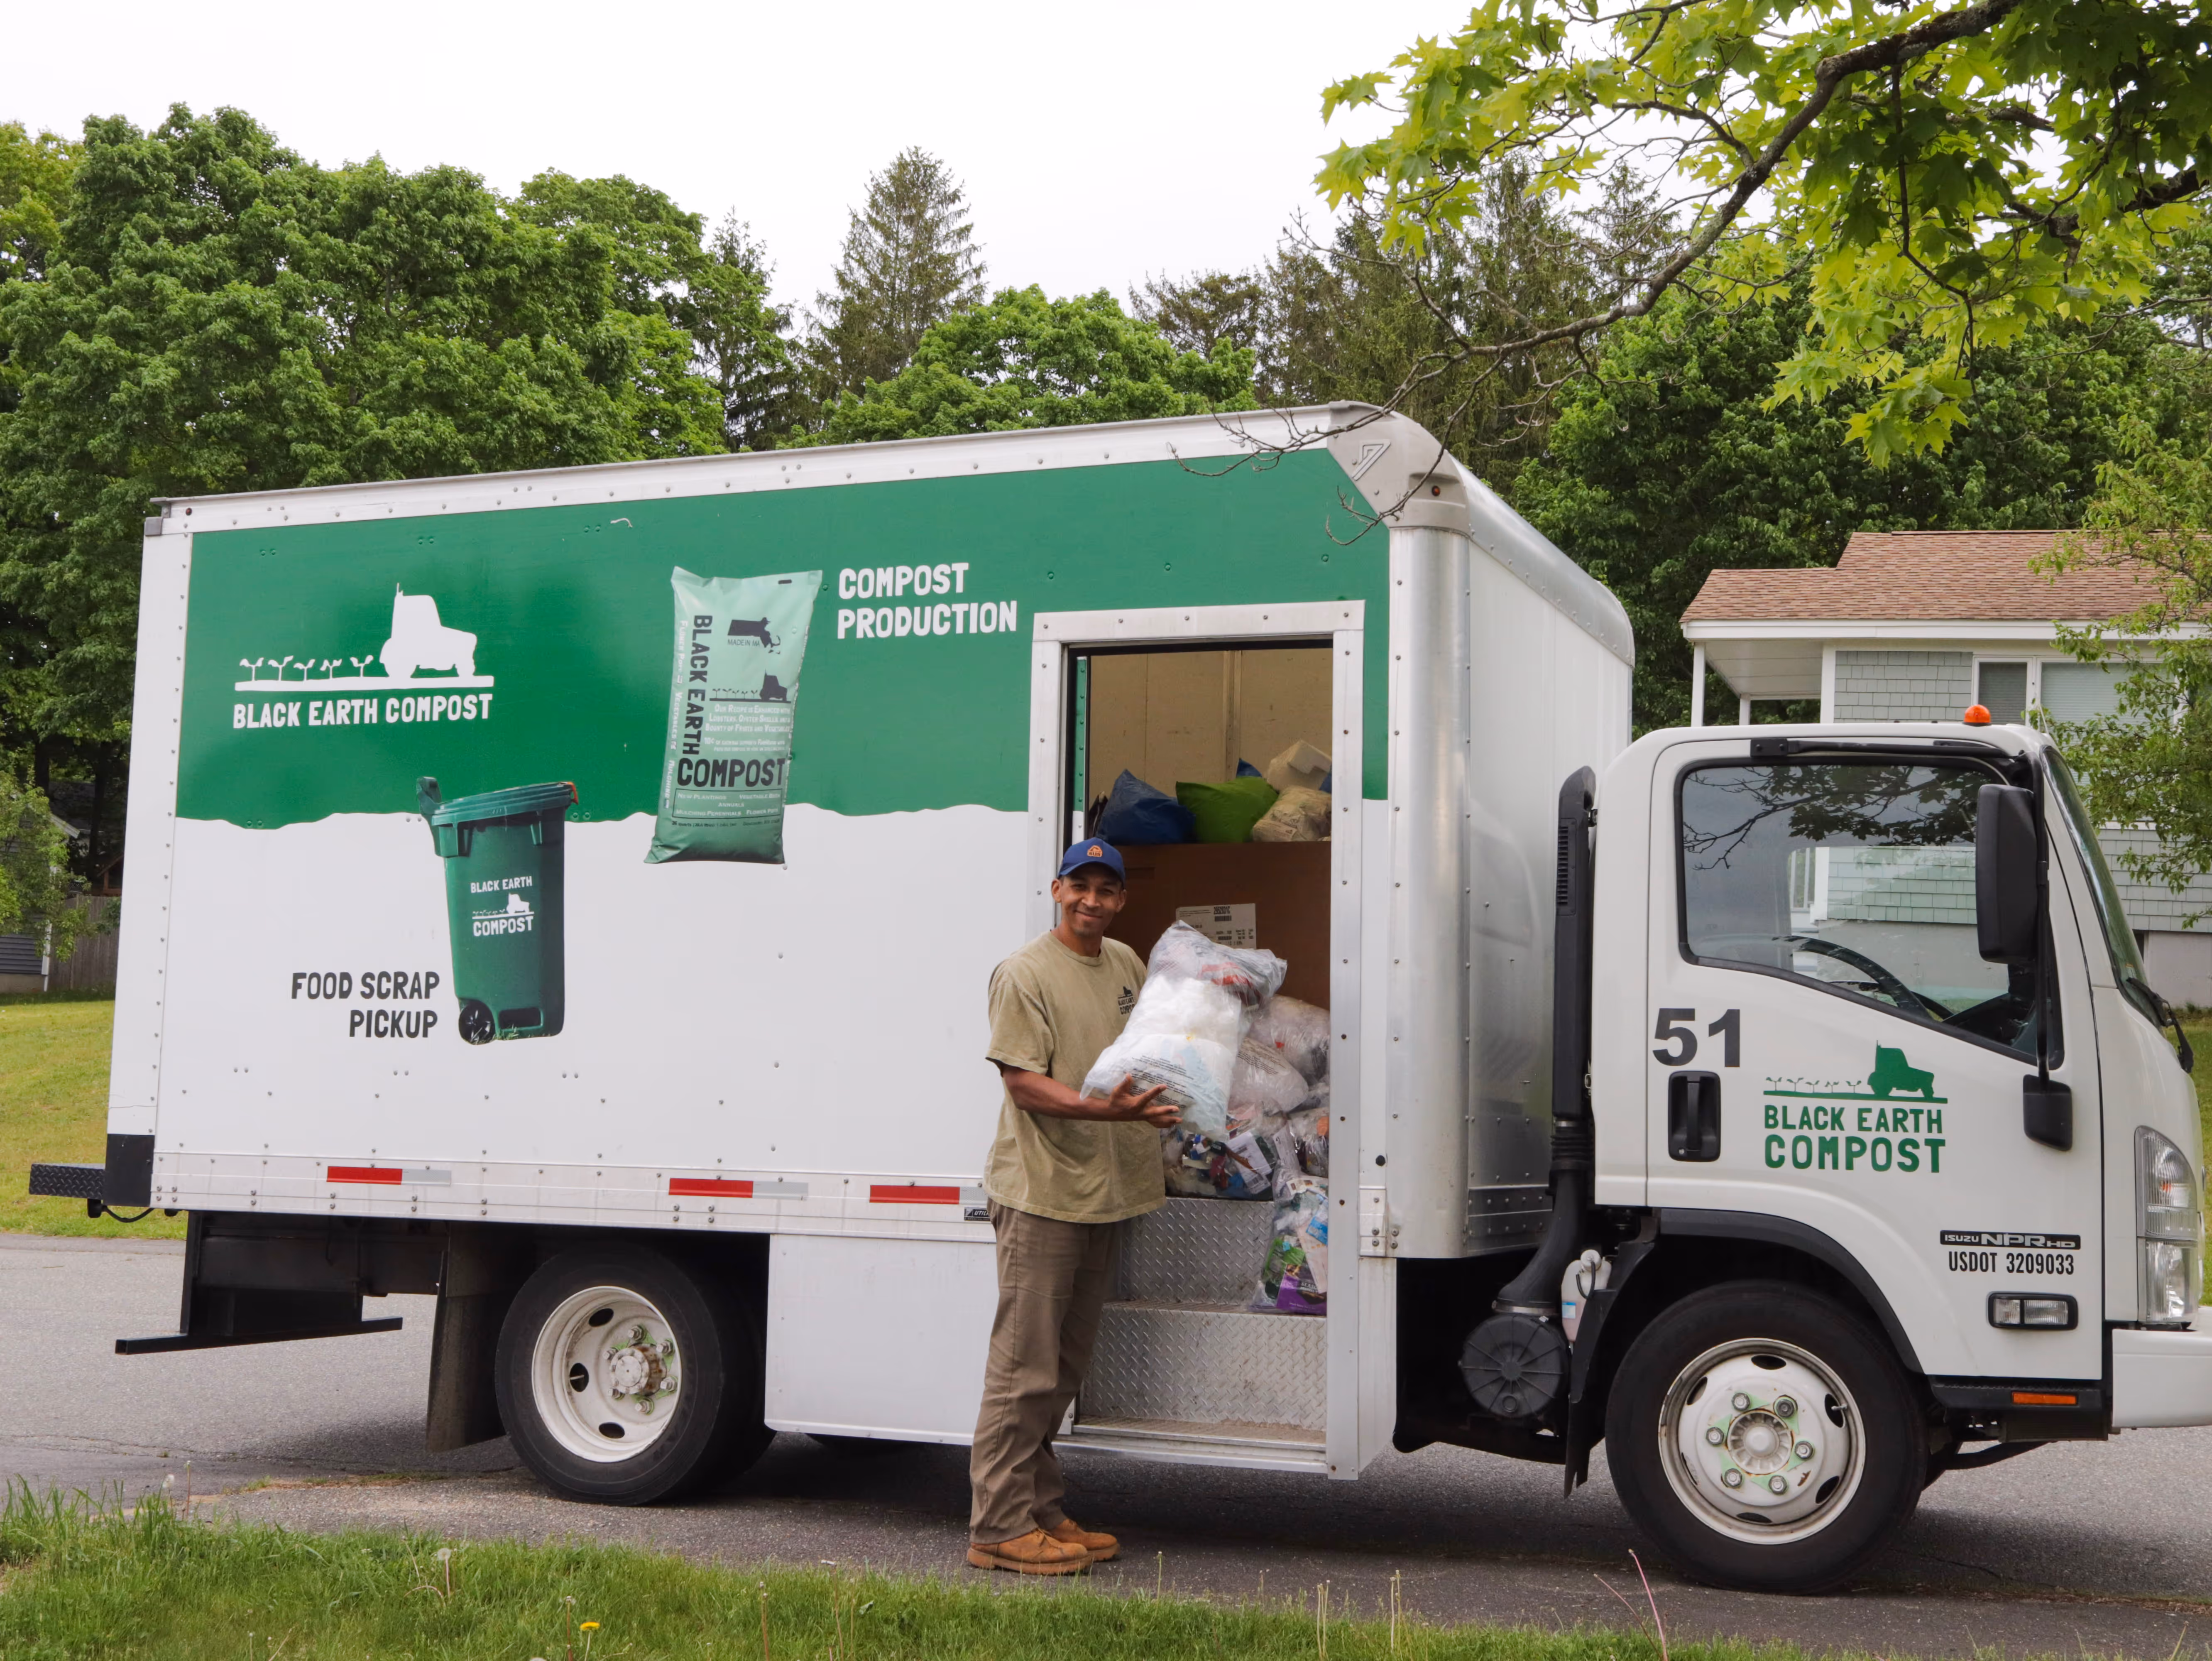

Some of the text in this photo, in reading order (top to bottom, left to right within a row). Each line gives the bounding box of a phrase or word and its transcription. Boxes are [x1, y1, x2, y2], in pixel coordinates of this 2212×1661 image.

[839, 562, 969, 599] COMPOST
[838, 600, 1017, 639] PRODUCTION
[683, 615, 713, 755] BLACK EARTH
[233, 693, 493, 729] BLACK EARTH COMPOST
[677, 757, 785, 787] COMPOST
[470, 876, 532, 893] BLACK EARTH
[472, 916, 533, 936] COMPOST
[291, 971, 440, 1000] FOOD SCRAP
[349, 1009, 438, 1038] PICKUP
[1652, 1008, 1740, 1068] 51
[1764, 1105, 1943, 1134] BLACK EARTH
[1765, 1134, 1946, 1173] COMPOST
[1981, 1233, 2046, 1247] NPR
[1949, 1251, 2074, 1275] USDOT 3209033
